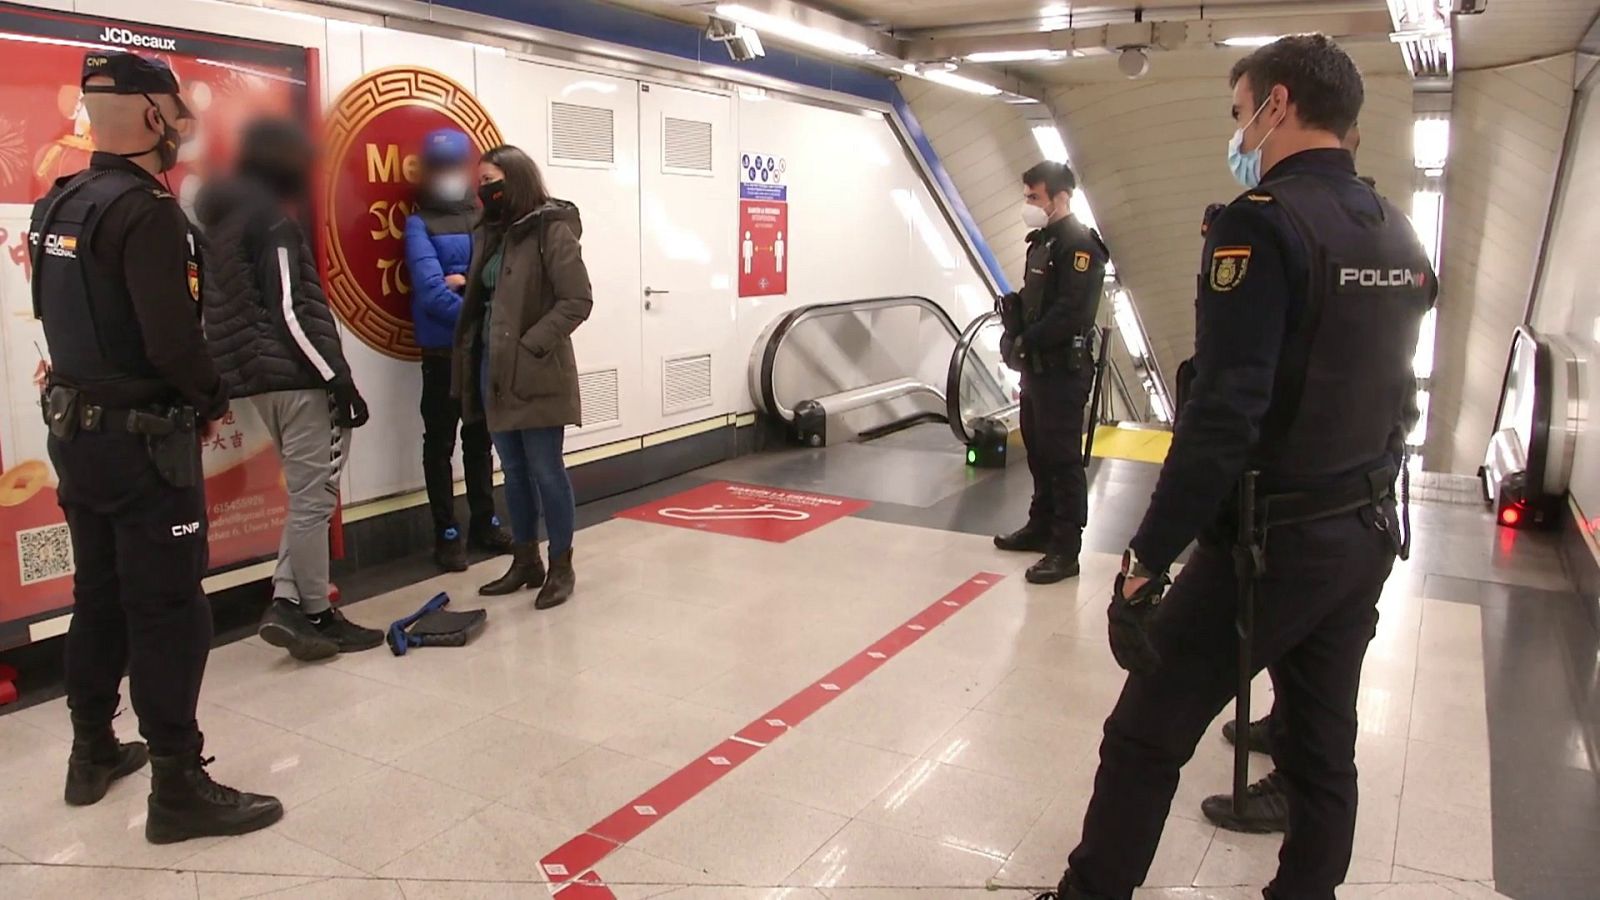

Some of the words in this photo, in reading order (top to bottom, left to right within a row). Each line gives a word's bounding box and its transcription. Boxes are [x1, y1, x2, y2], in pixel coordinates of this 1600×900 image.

[100, 27, 176, 50] JCDecaux
[86, 57, 107, 67] CNP
[366, 143, 421, 183] Me
[1340, 268, 1415, 287] POLICIA
[171, 521, 200, 537] CNP
